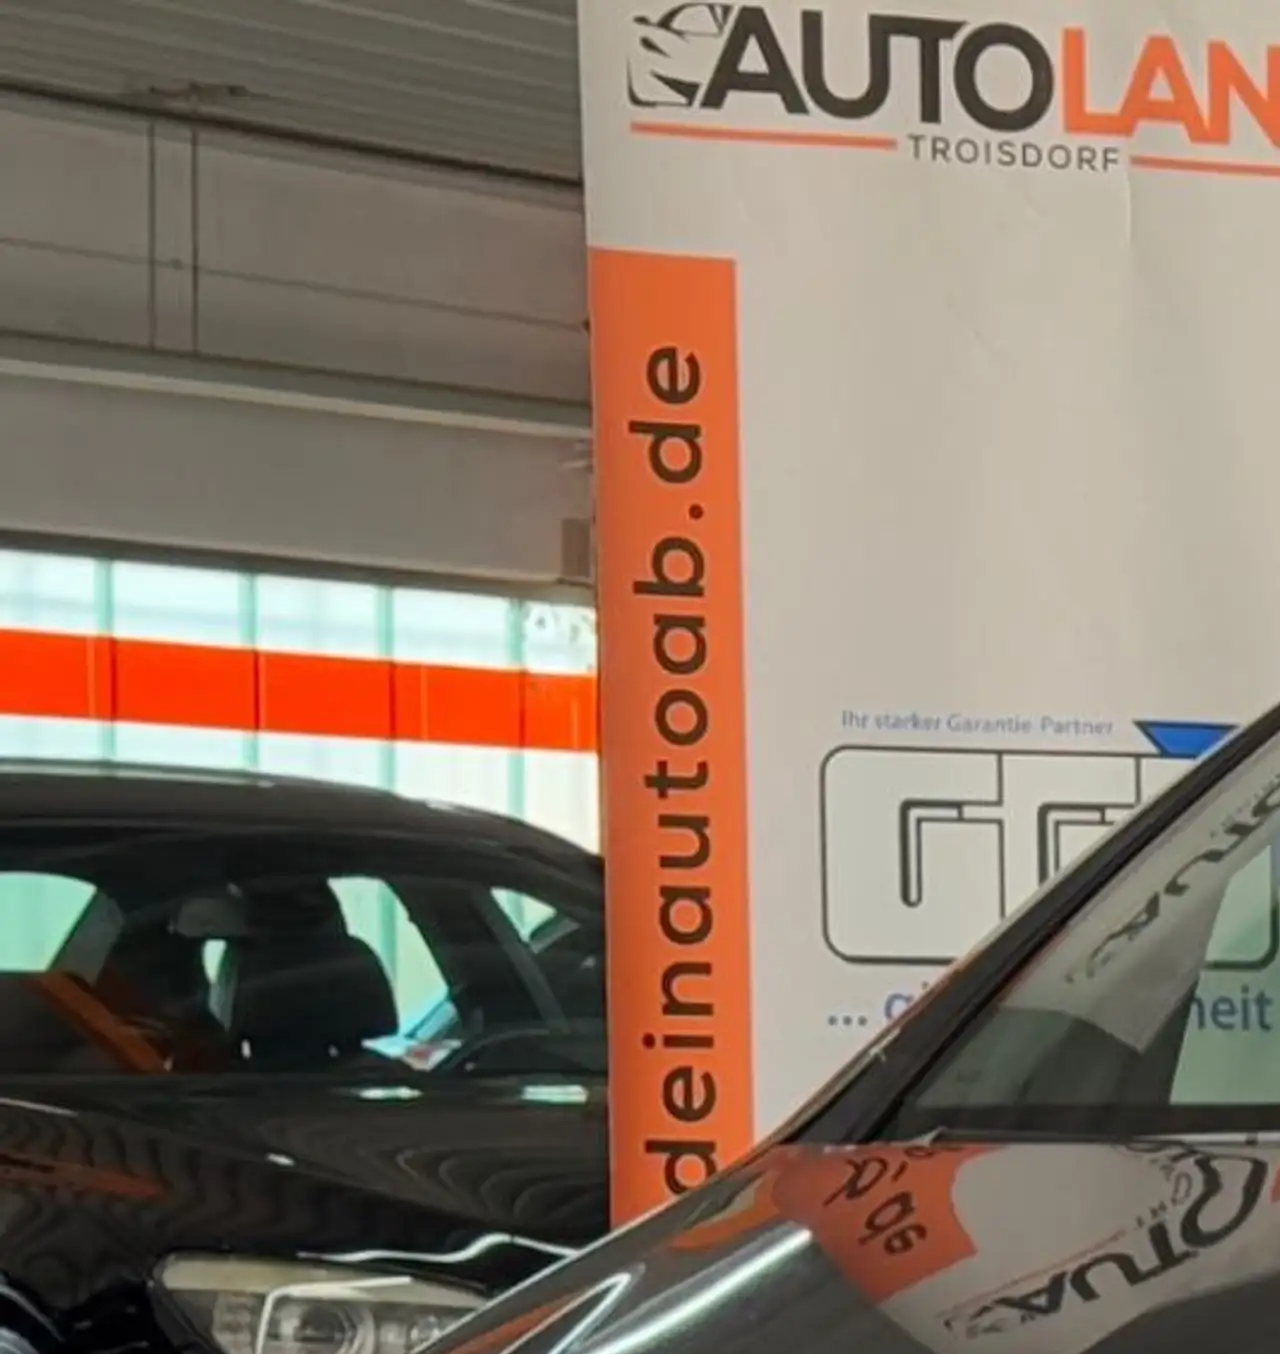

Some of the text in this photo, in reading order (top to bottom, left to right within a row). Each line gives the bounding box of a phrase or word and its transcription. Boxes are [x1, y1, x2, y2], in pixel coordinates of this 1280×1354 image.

[909, 134, 1120, 174] TROISDORF
[841, 710, 1113, 736] Ihr starker Garantie Partner
[628, 345, 717, 1195] deinautoab.de
